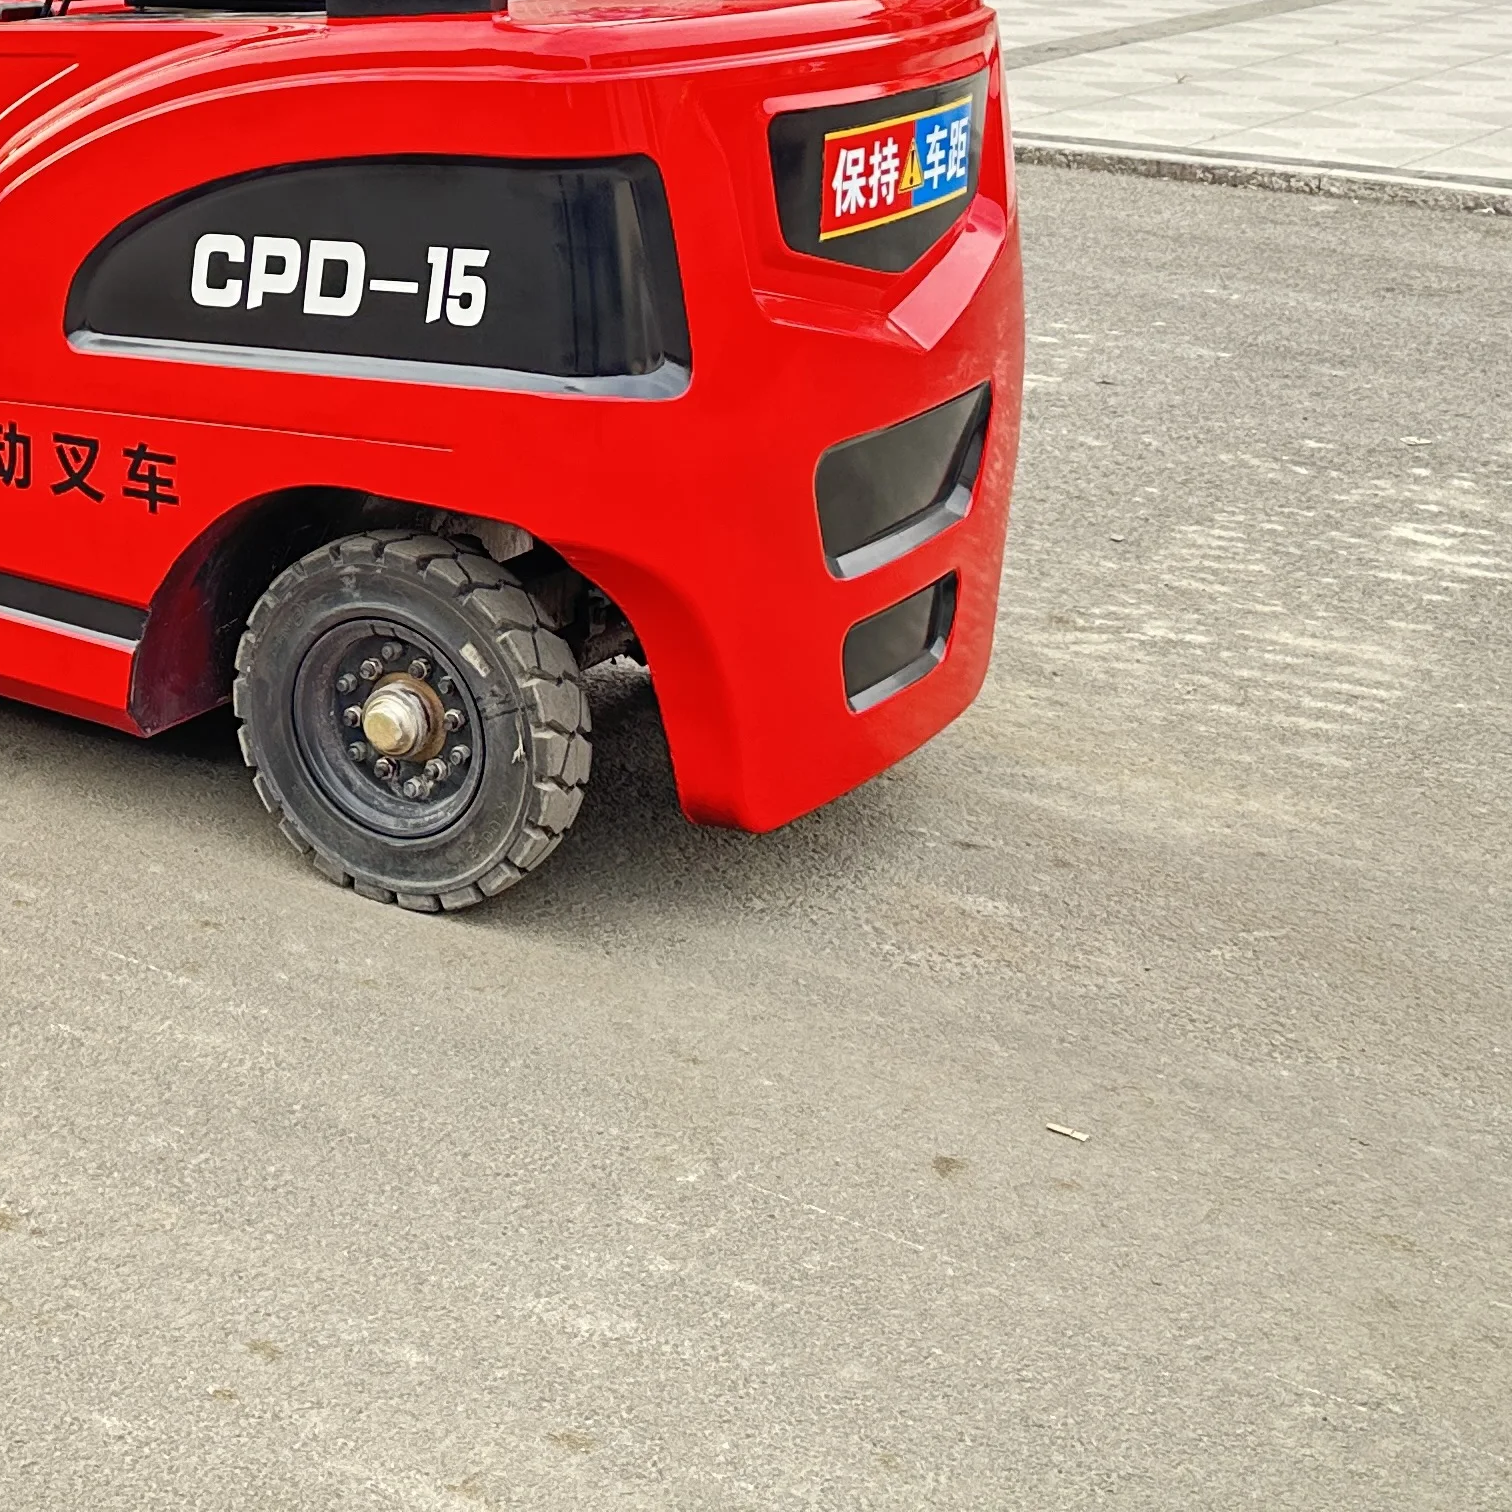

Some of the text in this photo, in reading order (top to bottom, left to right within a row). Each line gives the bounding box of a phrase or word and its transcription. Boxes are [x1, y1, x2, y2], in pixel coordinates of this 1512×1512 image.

[832, 116, 971, 217] 保持 车距
[191, 233, 490, 327] CPD-15
